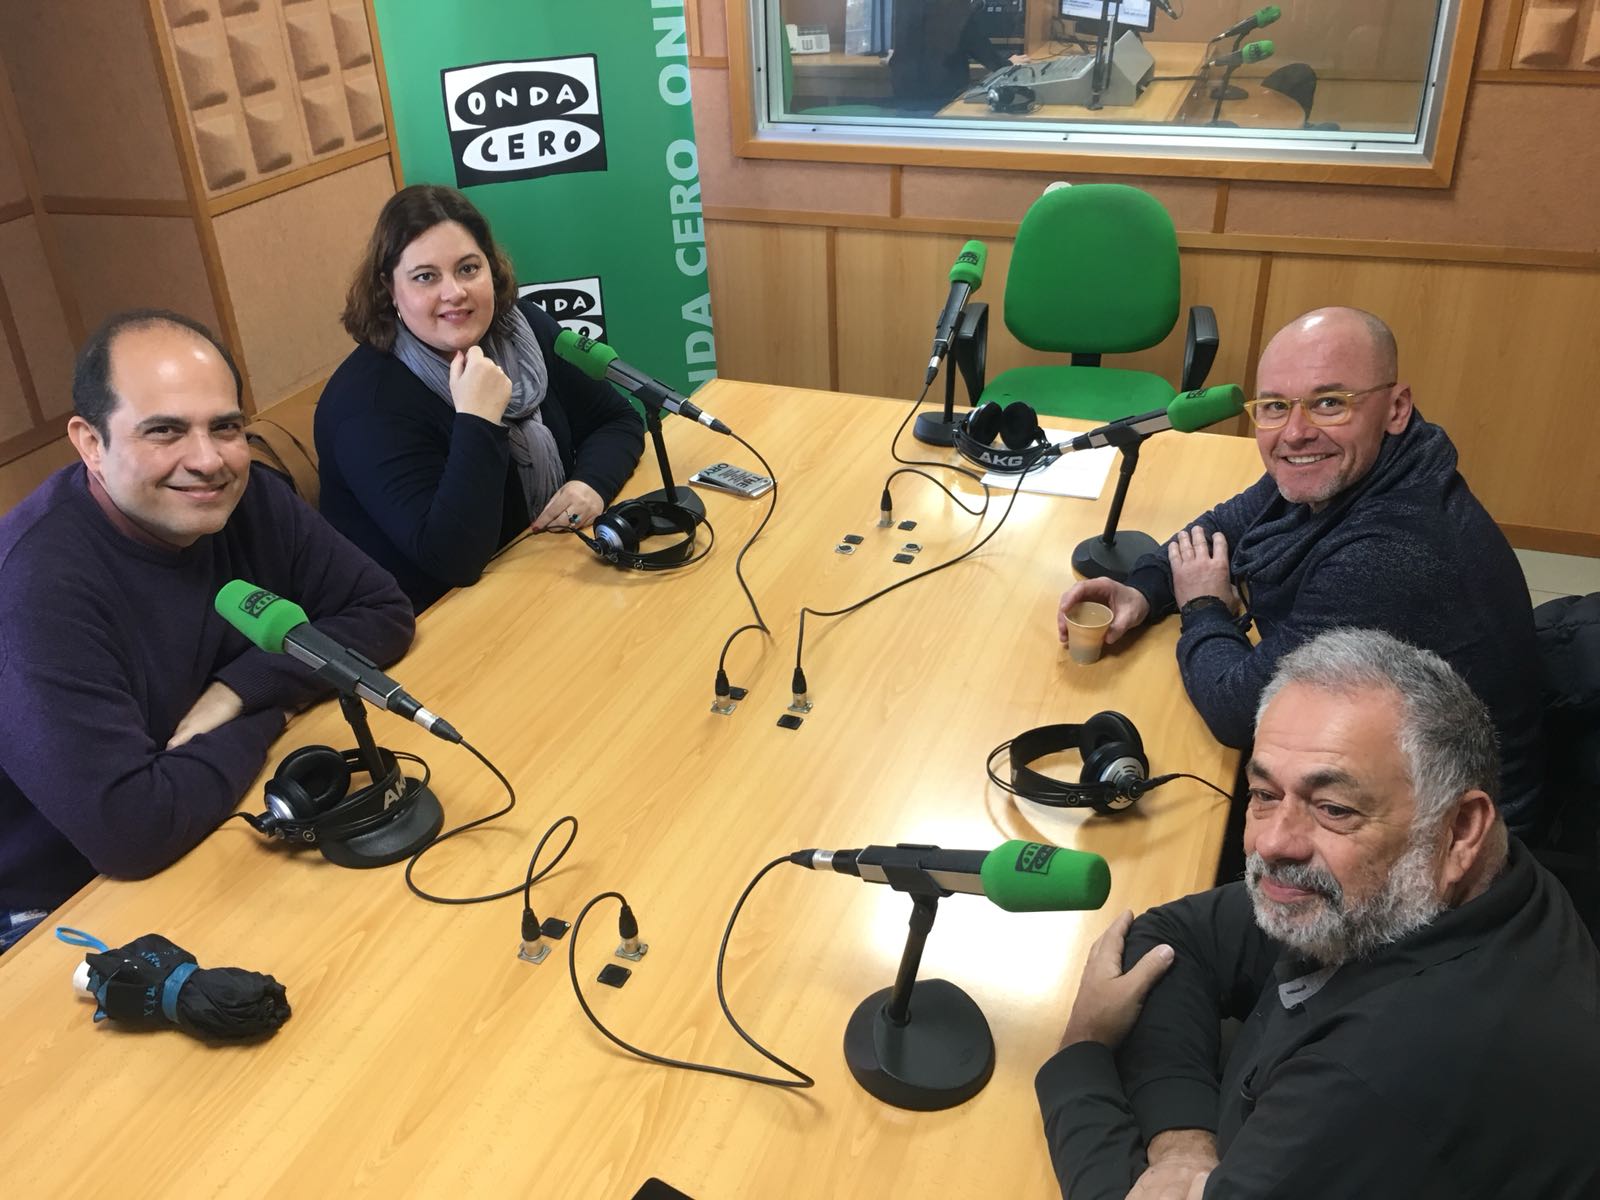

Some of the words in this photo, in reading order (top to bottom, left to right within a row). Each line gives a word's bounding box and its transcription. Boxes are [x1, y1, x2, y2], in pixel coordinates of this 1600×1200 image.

[651, 0, 691, 106] ON
[467, 83, 576, 115] ONDA
[480, 130, 581, 162] CERO
[666, 139, 708, 276] CERO
[533, 296, 587, 312] NDA
[979, 452, 1023, 467] AKG
[384, 776, 407, 810] AK
